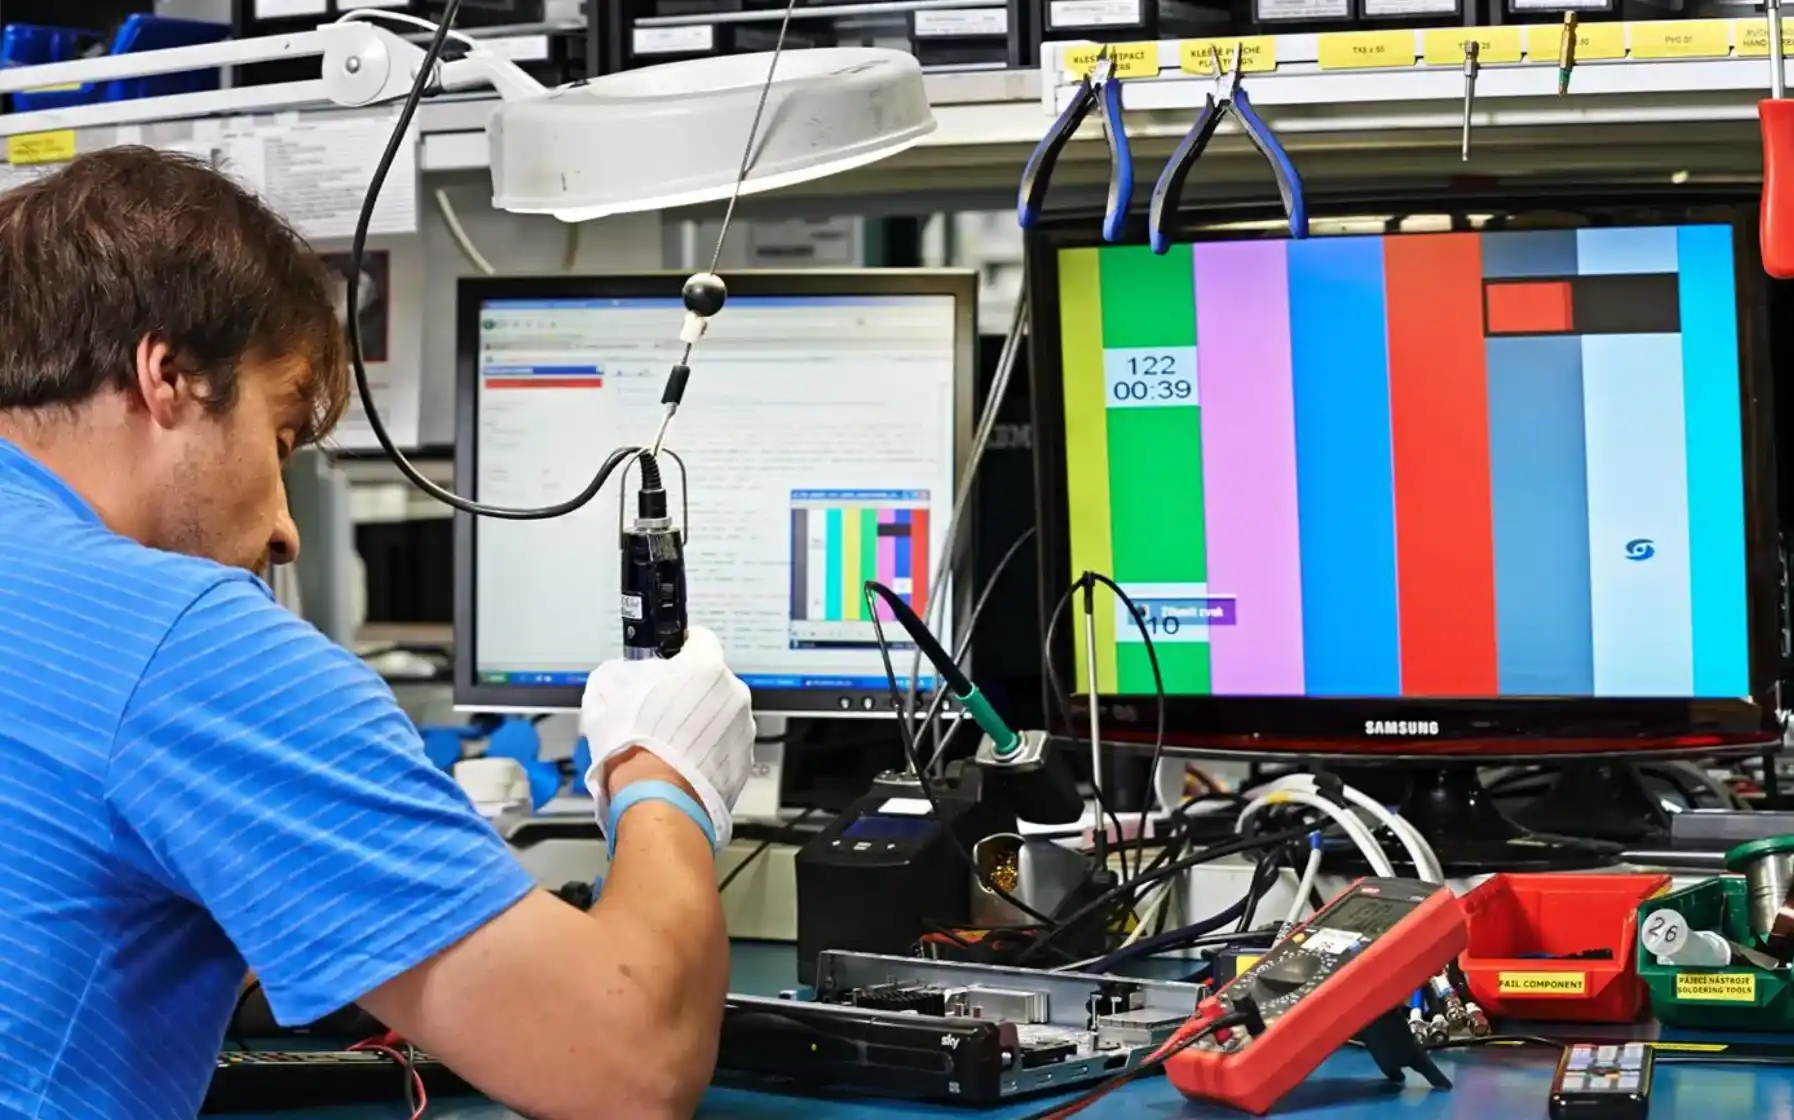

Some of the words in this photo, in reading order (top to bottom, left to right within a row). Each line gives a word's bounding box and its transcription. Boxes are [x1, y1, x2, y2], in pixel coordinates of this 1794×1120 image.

[1127, 355, 1176, 375] 122
[1113, 379, 1192, 401] 00:39
[1145, 615, 1180, 635] 10
[1365, 720, 1439, 735] SAMSUNG
[1649, 916, 1679, 942] 26
[1497, 980, 1520, 988] FAIL
[1523, 980, 1582, 989] COMPONENT
[941, 1033, 960, 1050] sky
